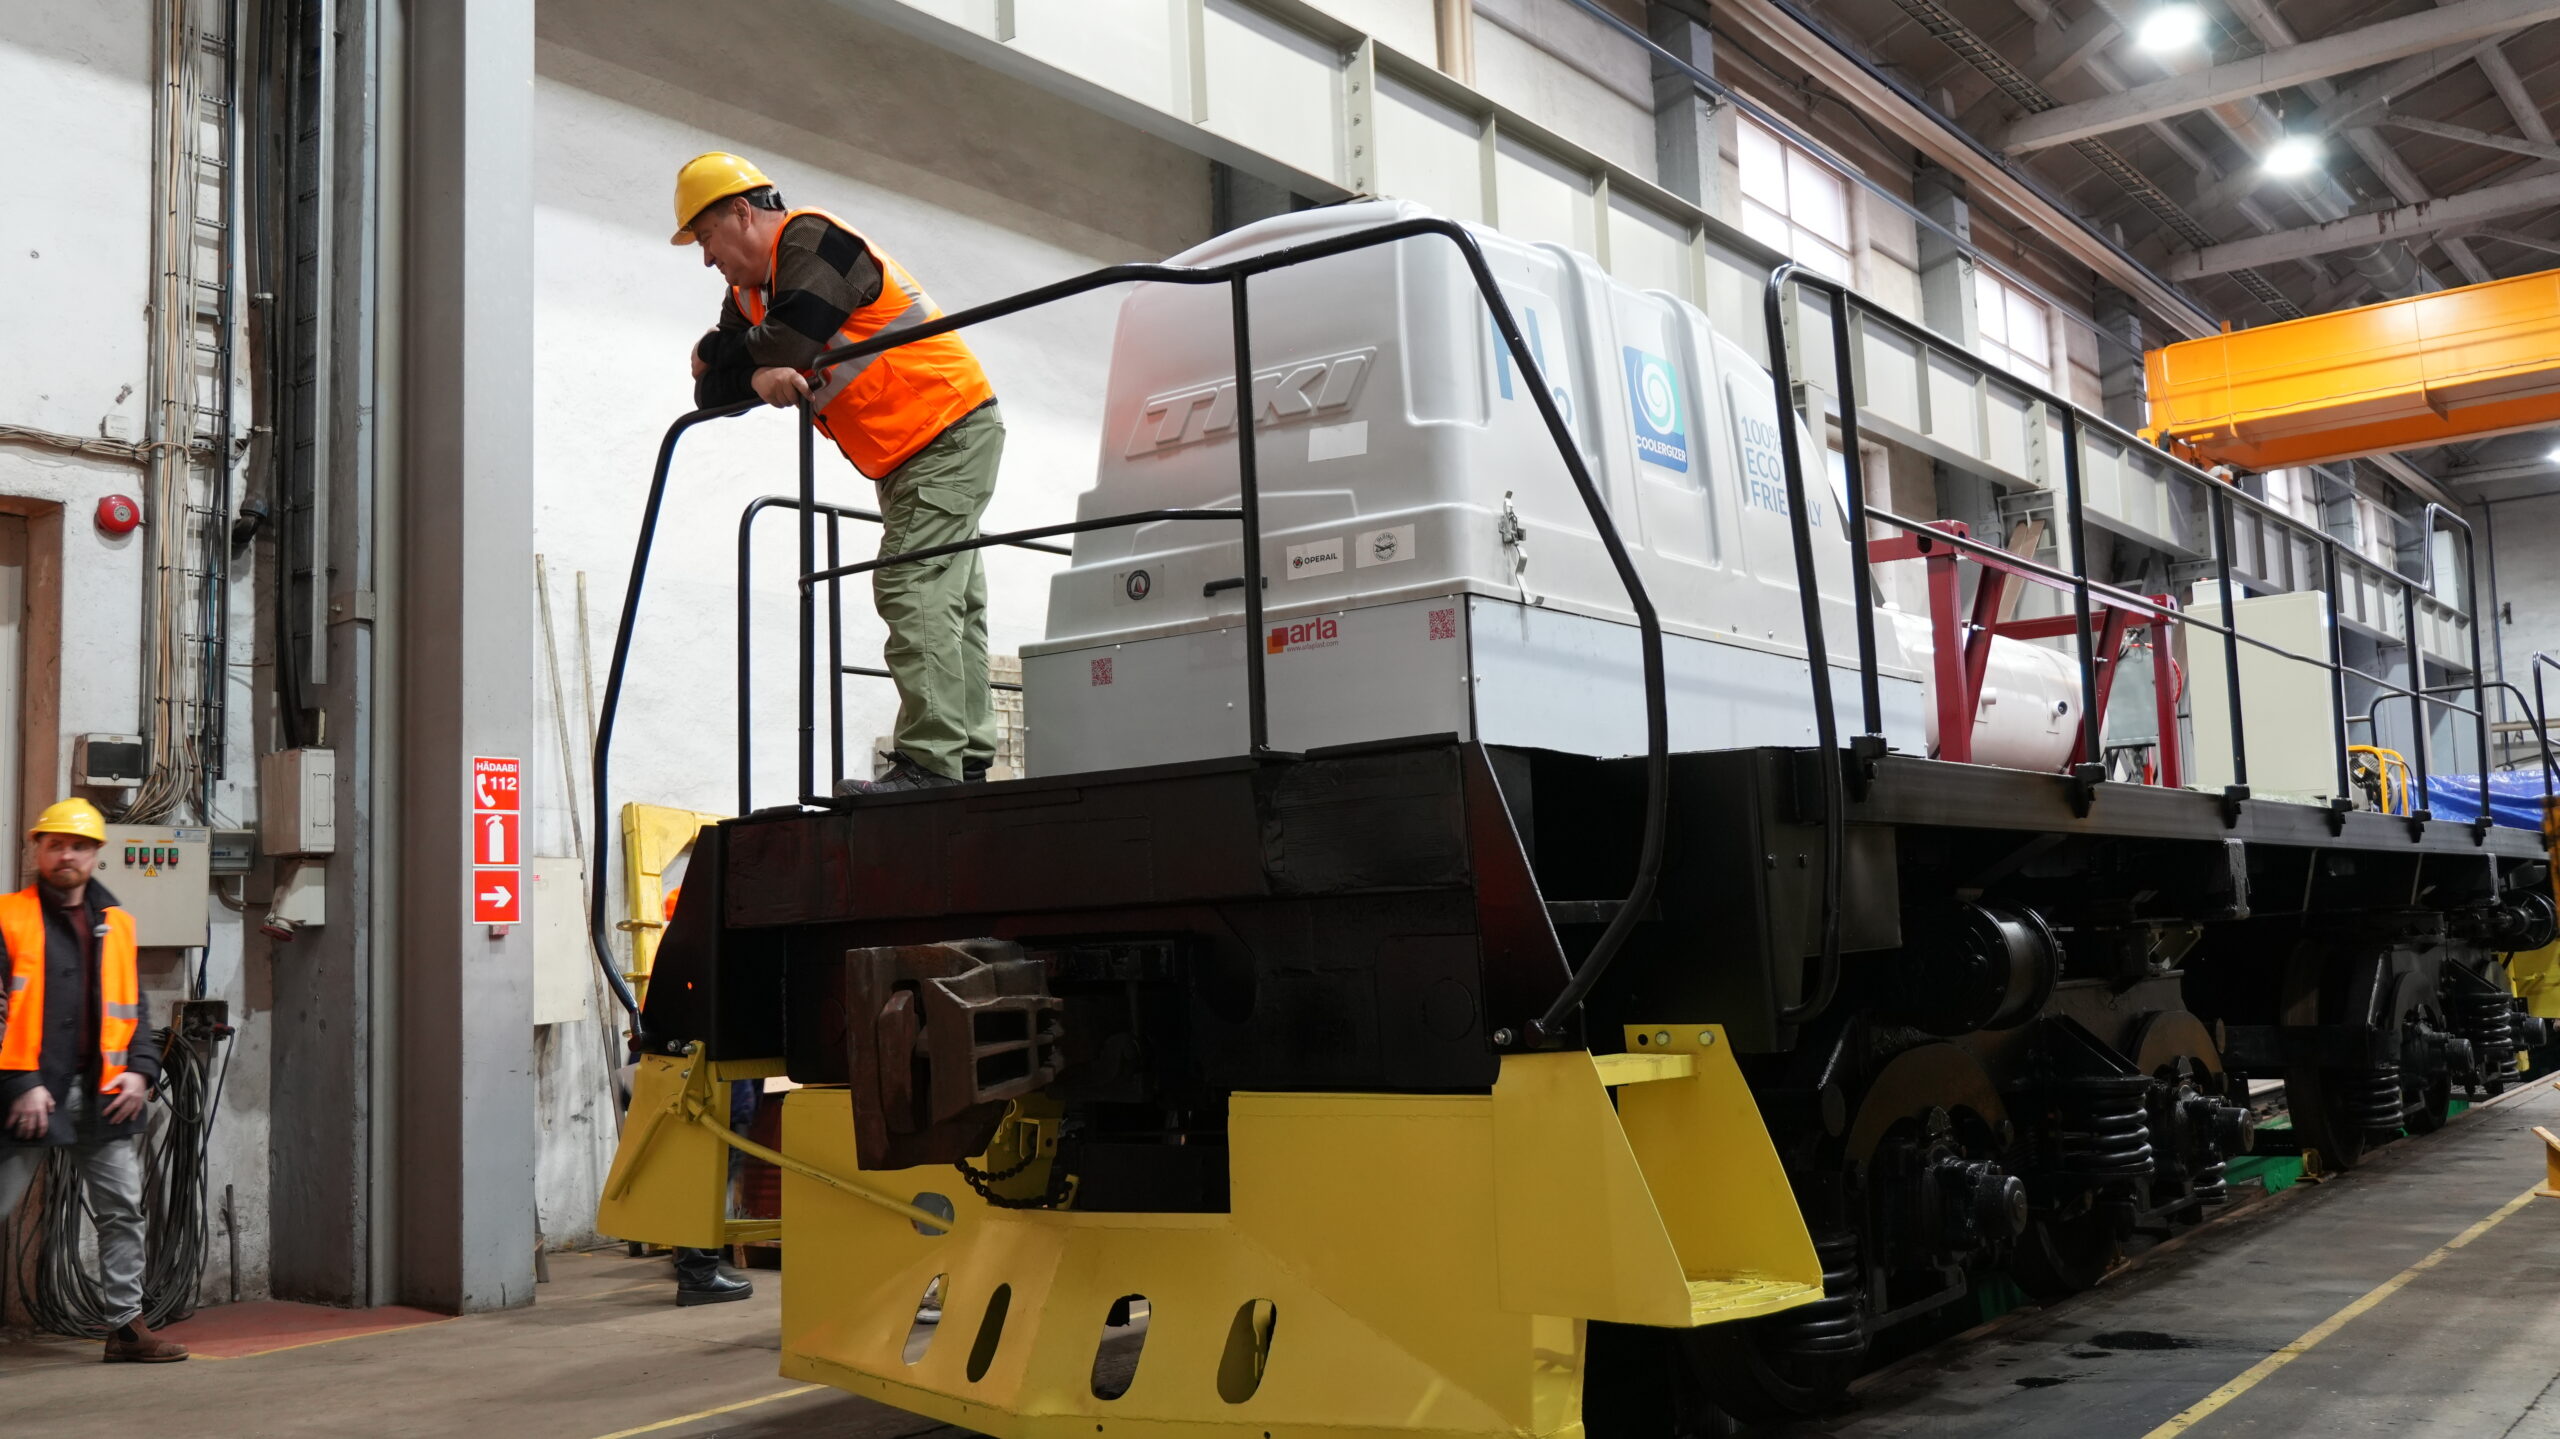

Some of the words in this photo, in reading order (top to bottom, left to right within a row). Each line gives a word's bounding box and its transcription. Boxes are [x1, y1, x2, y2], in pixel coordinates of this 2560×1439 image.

[1146, 355, 1368, 446] TIKI
[1635, 434, 1687, 463] COOLERGIZER
[1745, 447, 1781, 483] ECO
[1750, 479, 1822, 528] FRIELY
[1304, 552, 1338, 565] OPERAIL
[1290, 617, 1338, 644] arla
[476, 760, 518, 772] HÄDAABI
[490, 776, 517, 790] 112
